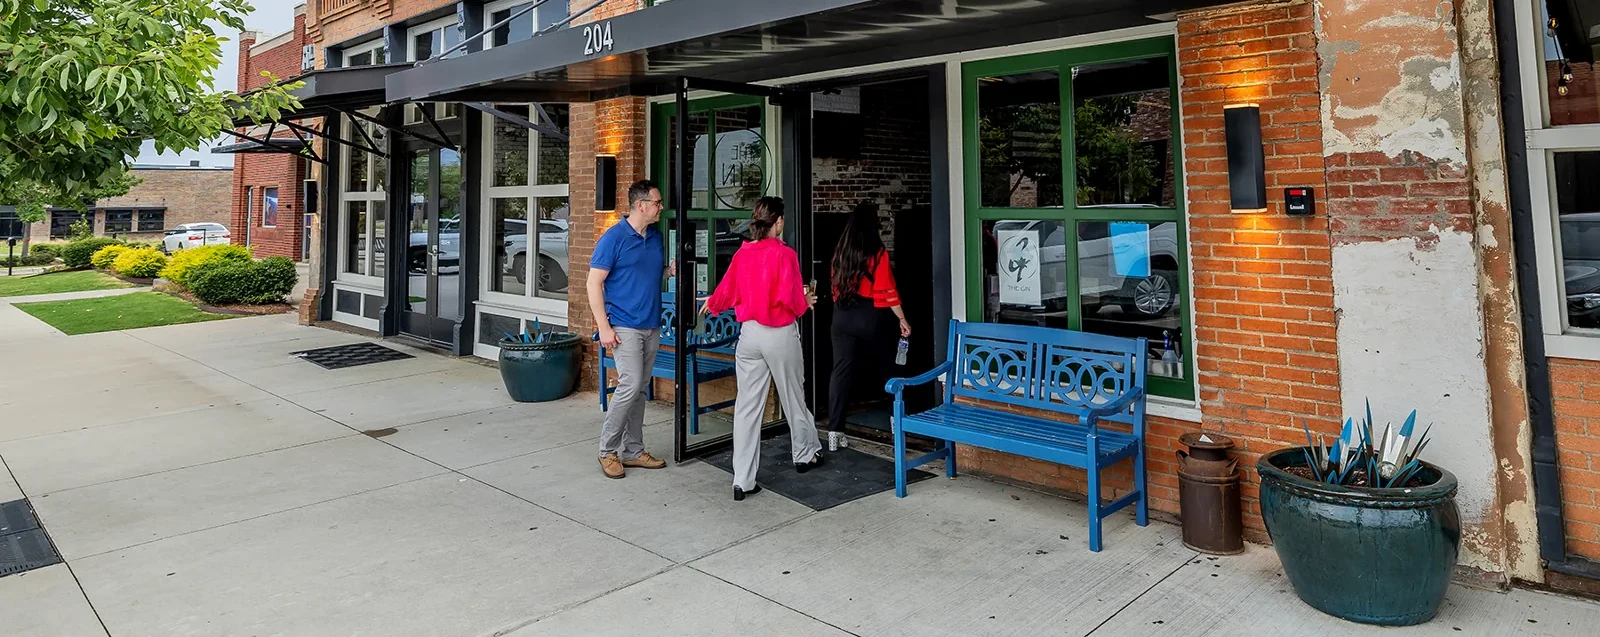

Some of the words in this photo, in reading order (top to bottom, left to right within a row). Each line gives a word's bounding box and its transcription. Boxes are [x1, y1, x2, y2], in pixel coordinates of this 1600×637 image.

[583, 20, 614, 56] 204
[1007, 284, 1020, 292] THE
[1020, 285, 1031, 293] GIN
